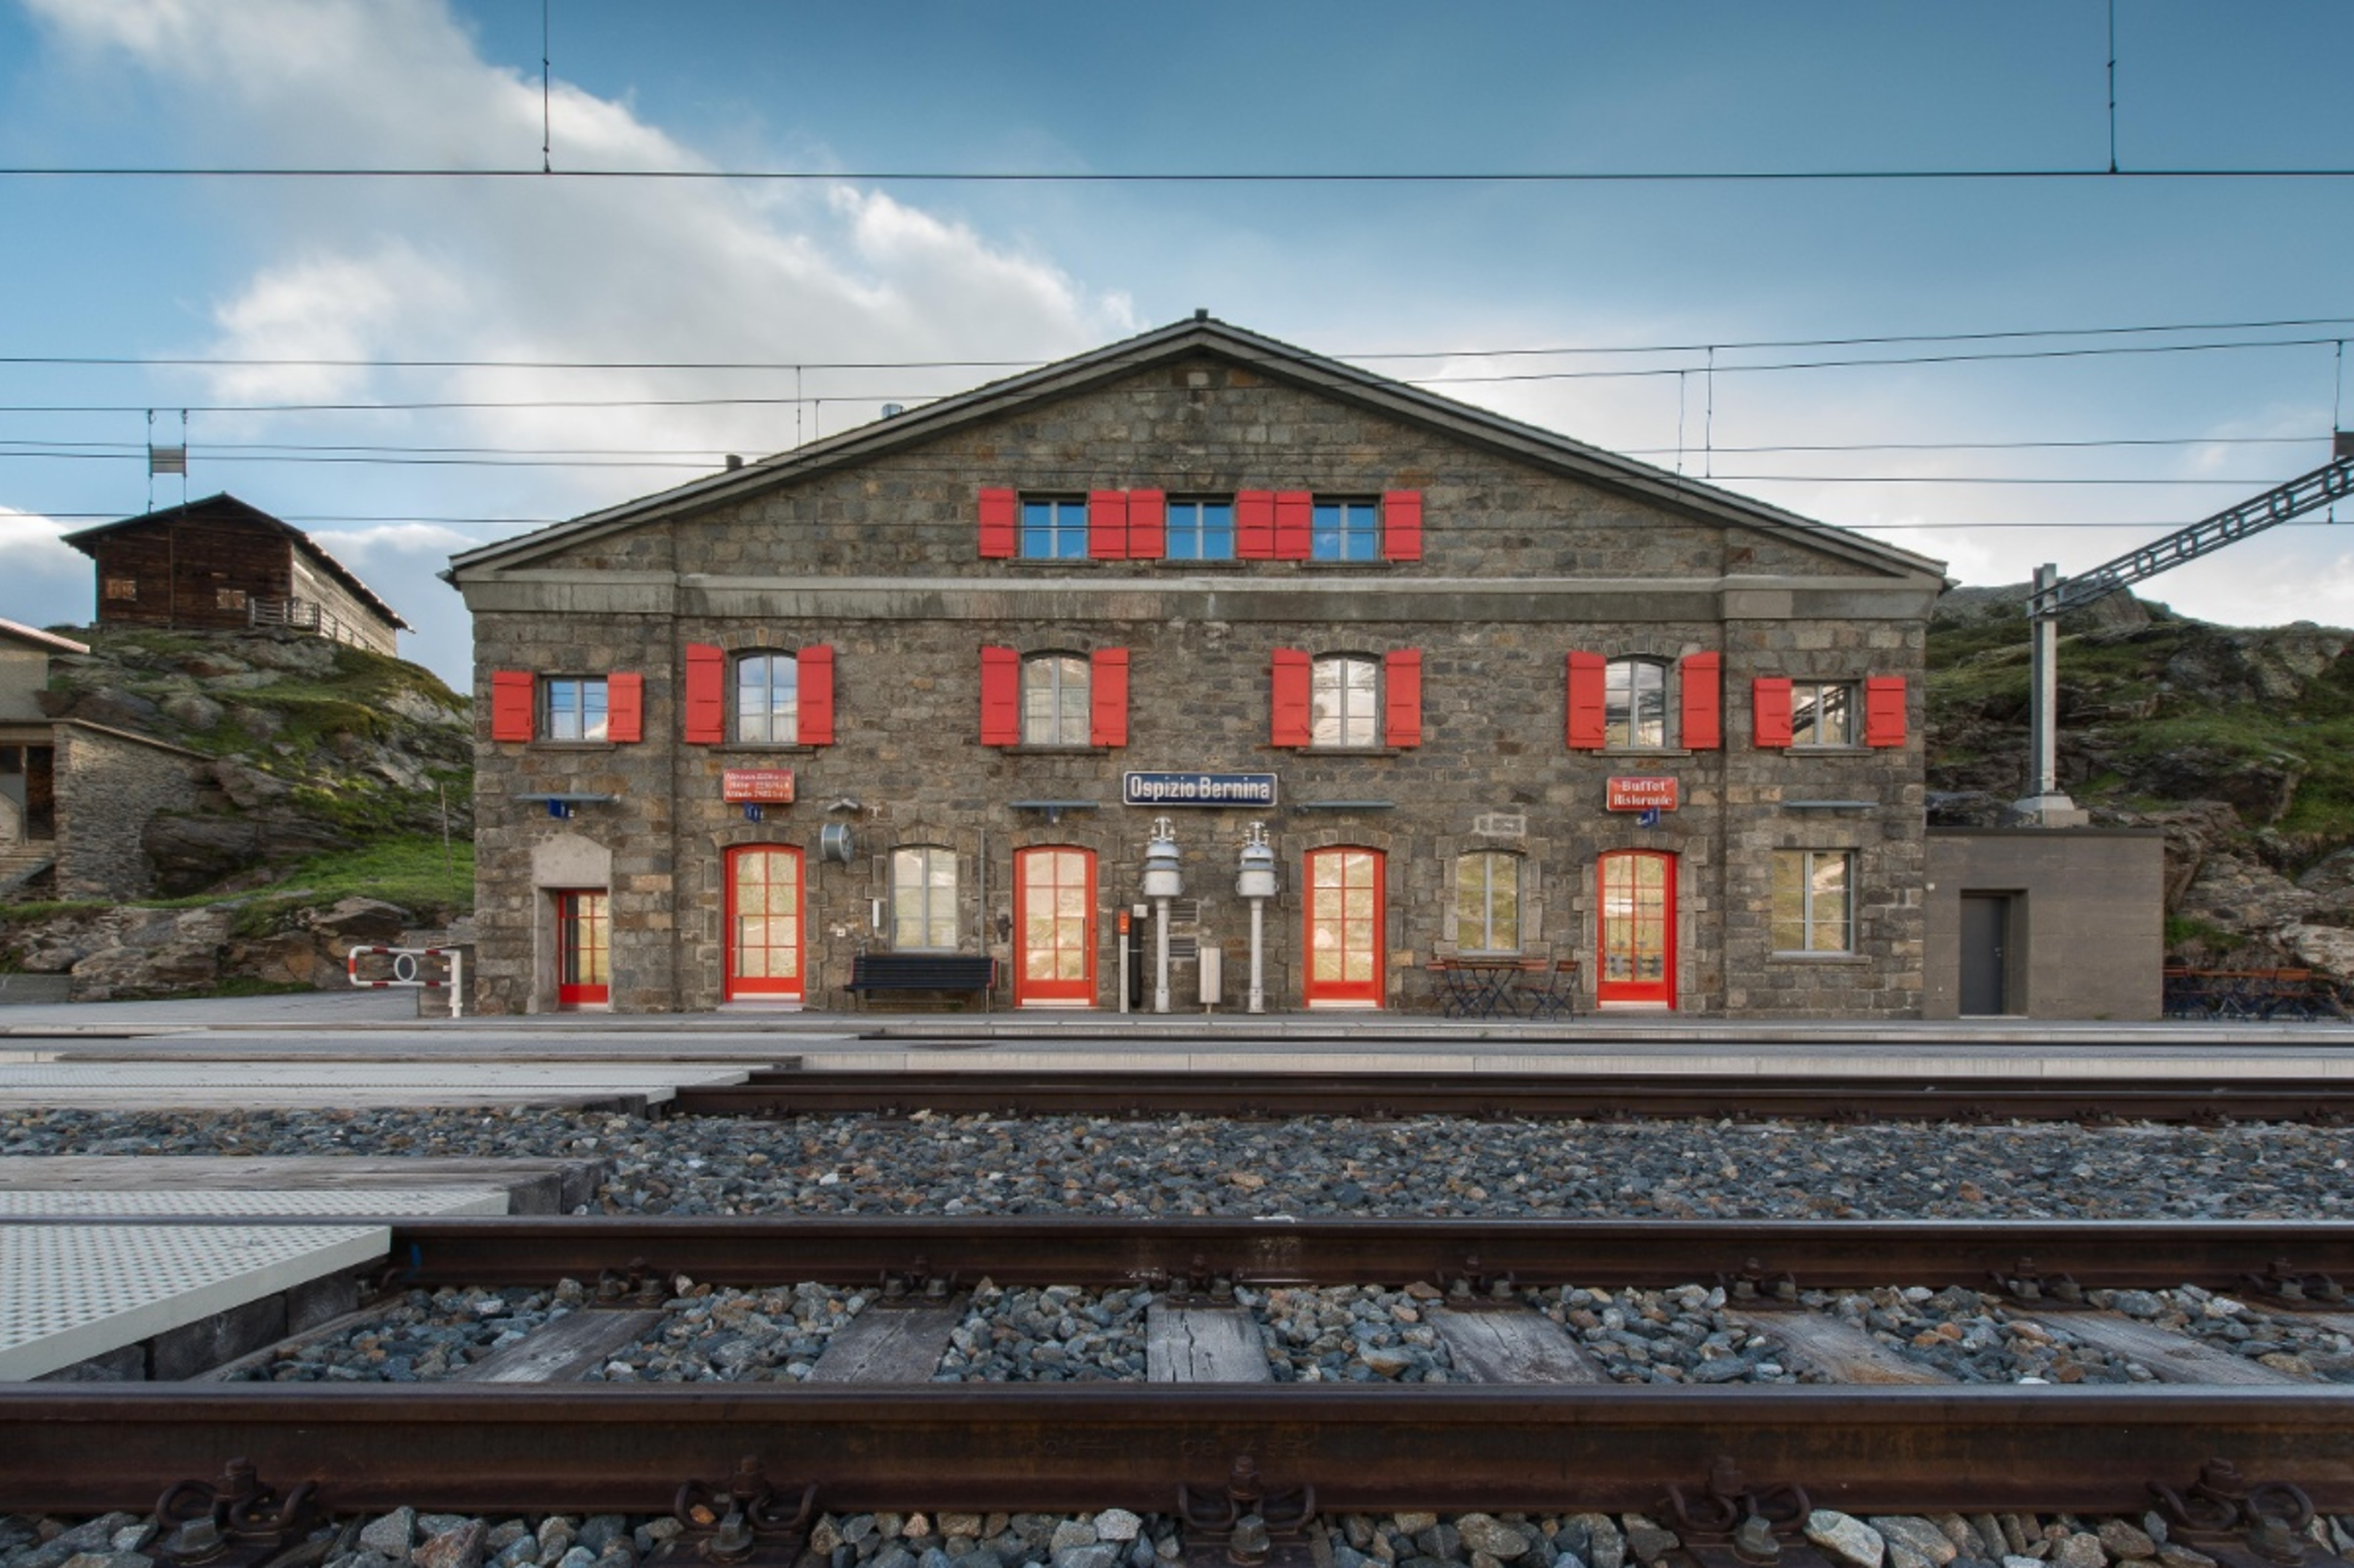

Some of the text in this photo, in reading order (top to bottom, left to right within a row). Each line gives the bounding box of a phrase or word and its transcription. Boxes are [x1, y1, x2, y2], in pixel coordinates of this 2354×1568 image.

[1131, 776, 1270, 801] Ospizio Bernina
[1622, 780, 1665, 791] Buffet
